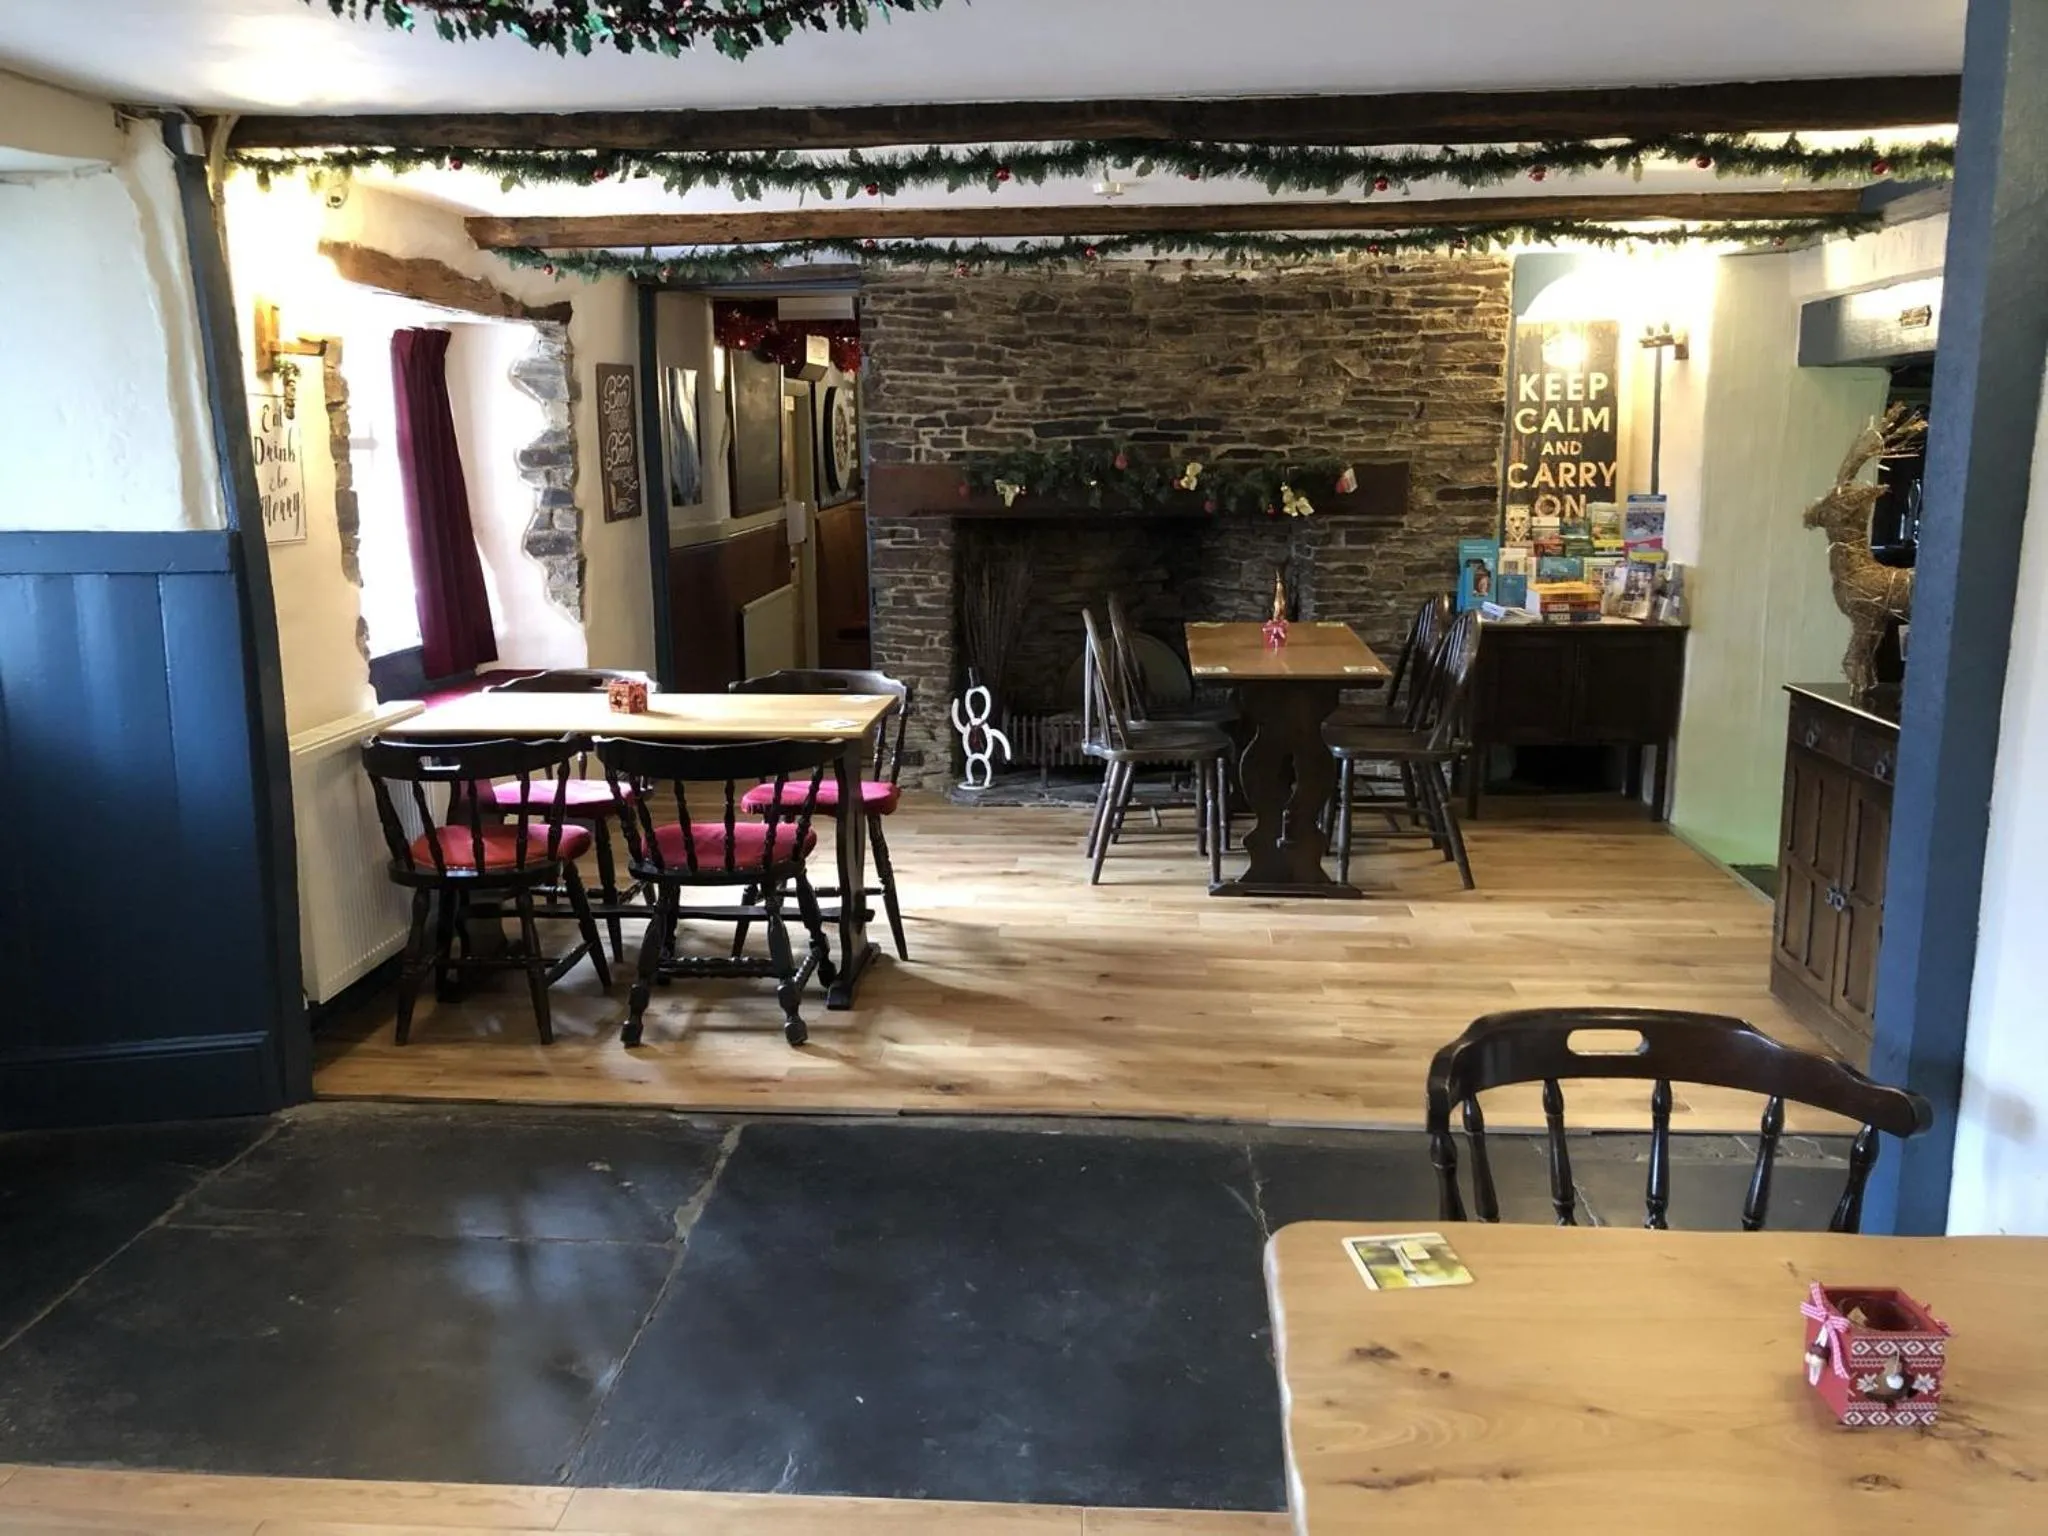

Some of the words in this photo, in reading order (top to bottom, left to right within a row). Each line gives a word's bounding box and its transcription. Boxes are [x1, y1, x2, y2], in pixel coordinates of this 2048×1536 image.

[1519, 373, 1609, 402] KEEP
[1514, 407, 1610, 434] CALM
[254, 427, 296, 466] Drink
[1541, 440, 1582, 456] AND
[1507, 462, 1617, 488] CARRY
[1534, 493, 1587, 519] ON
